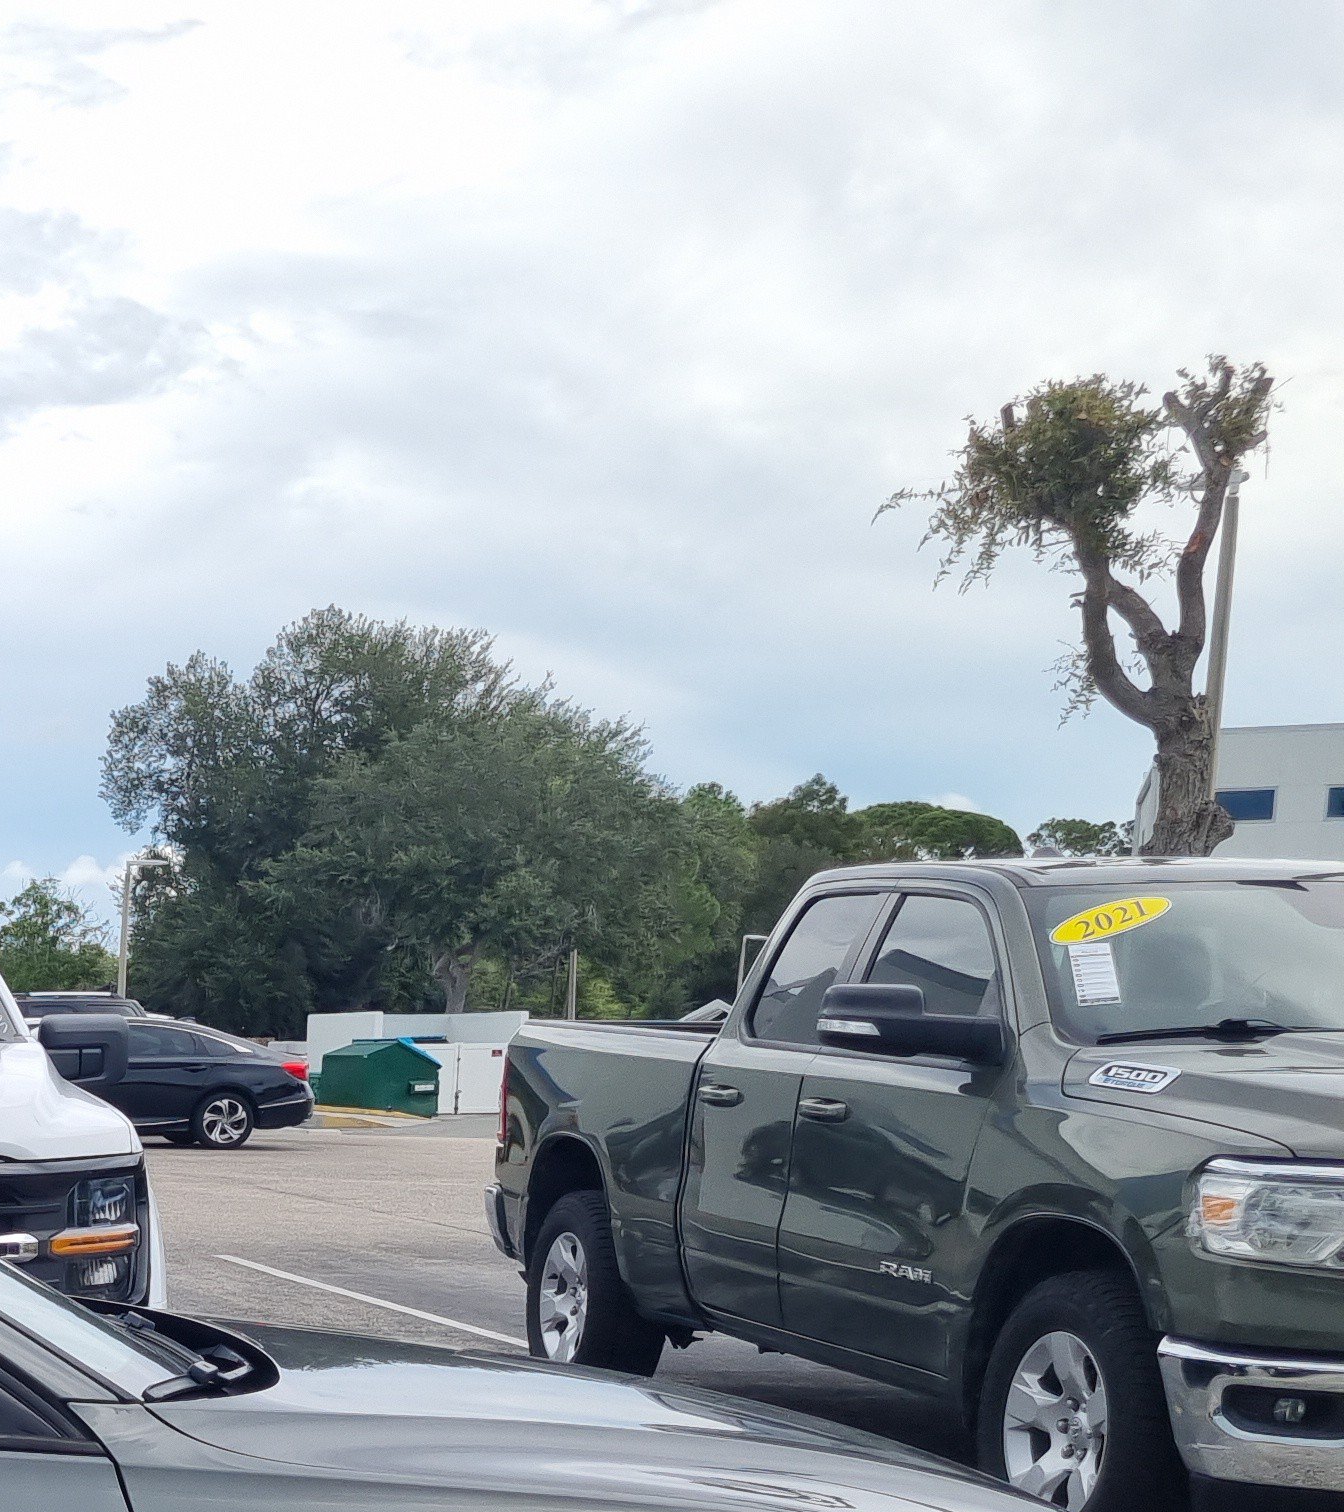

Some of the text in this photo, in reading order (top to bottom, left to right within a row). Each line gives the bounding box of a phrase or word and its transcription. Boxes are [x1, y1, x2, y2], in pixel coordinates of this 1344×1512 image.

[1075, 900, 1148, 939] 2021
[1107, 1066, 1166, 1084] 1500
[879, 1260, 933, 1284] RAM
